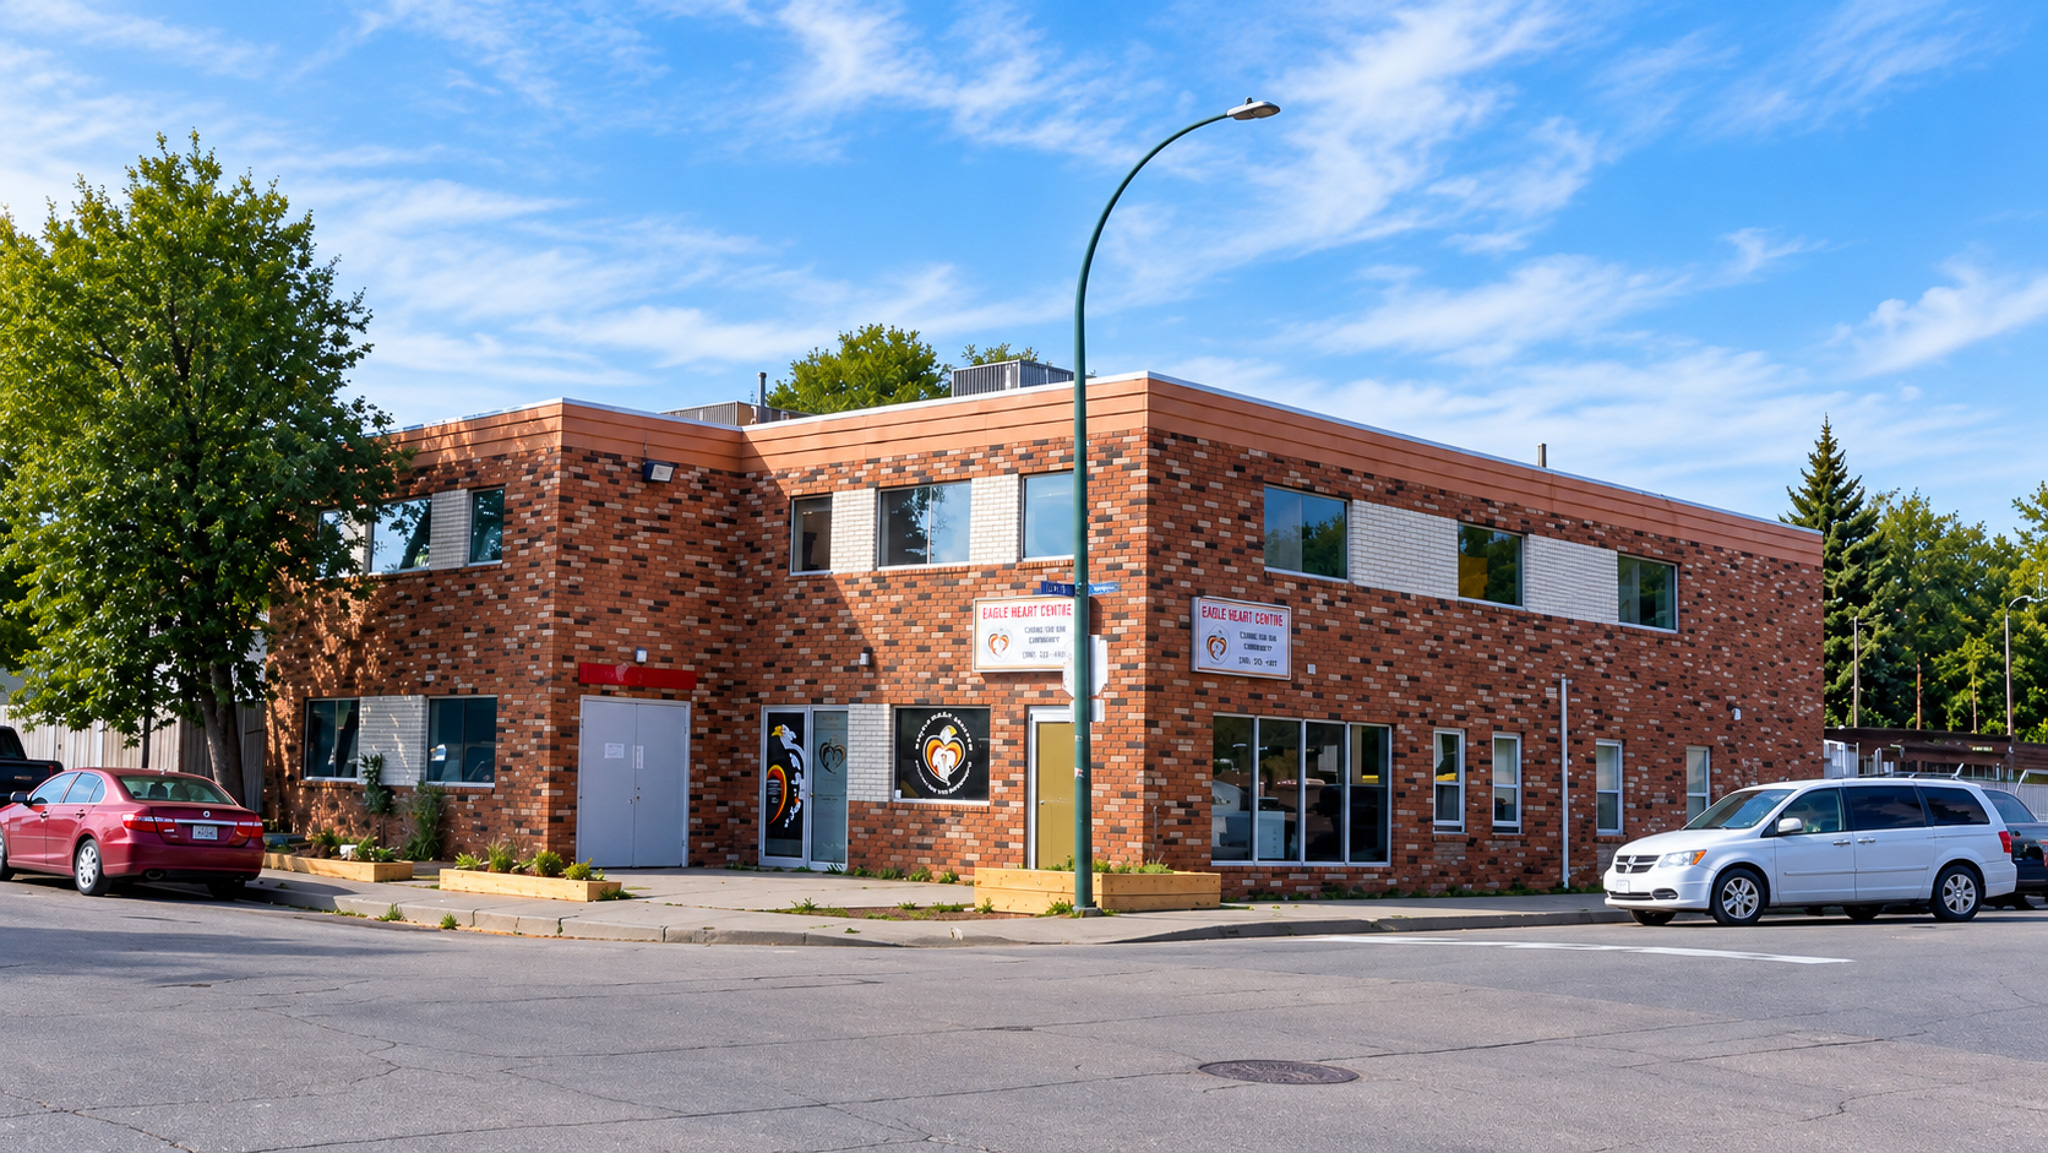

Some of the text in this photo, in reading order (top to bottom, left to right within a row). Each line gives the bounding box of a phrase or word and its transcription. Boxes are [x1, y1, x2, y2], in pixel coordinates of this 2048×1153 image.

[982, 603, 1072, 619] EAGLE HEART CENTRE
[1202, 606, 1283, 627] EAGLE HEART CENTRE
